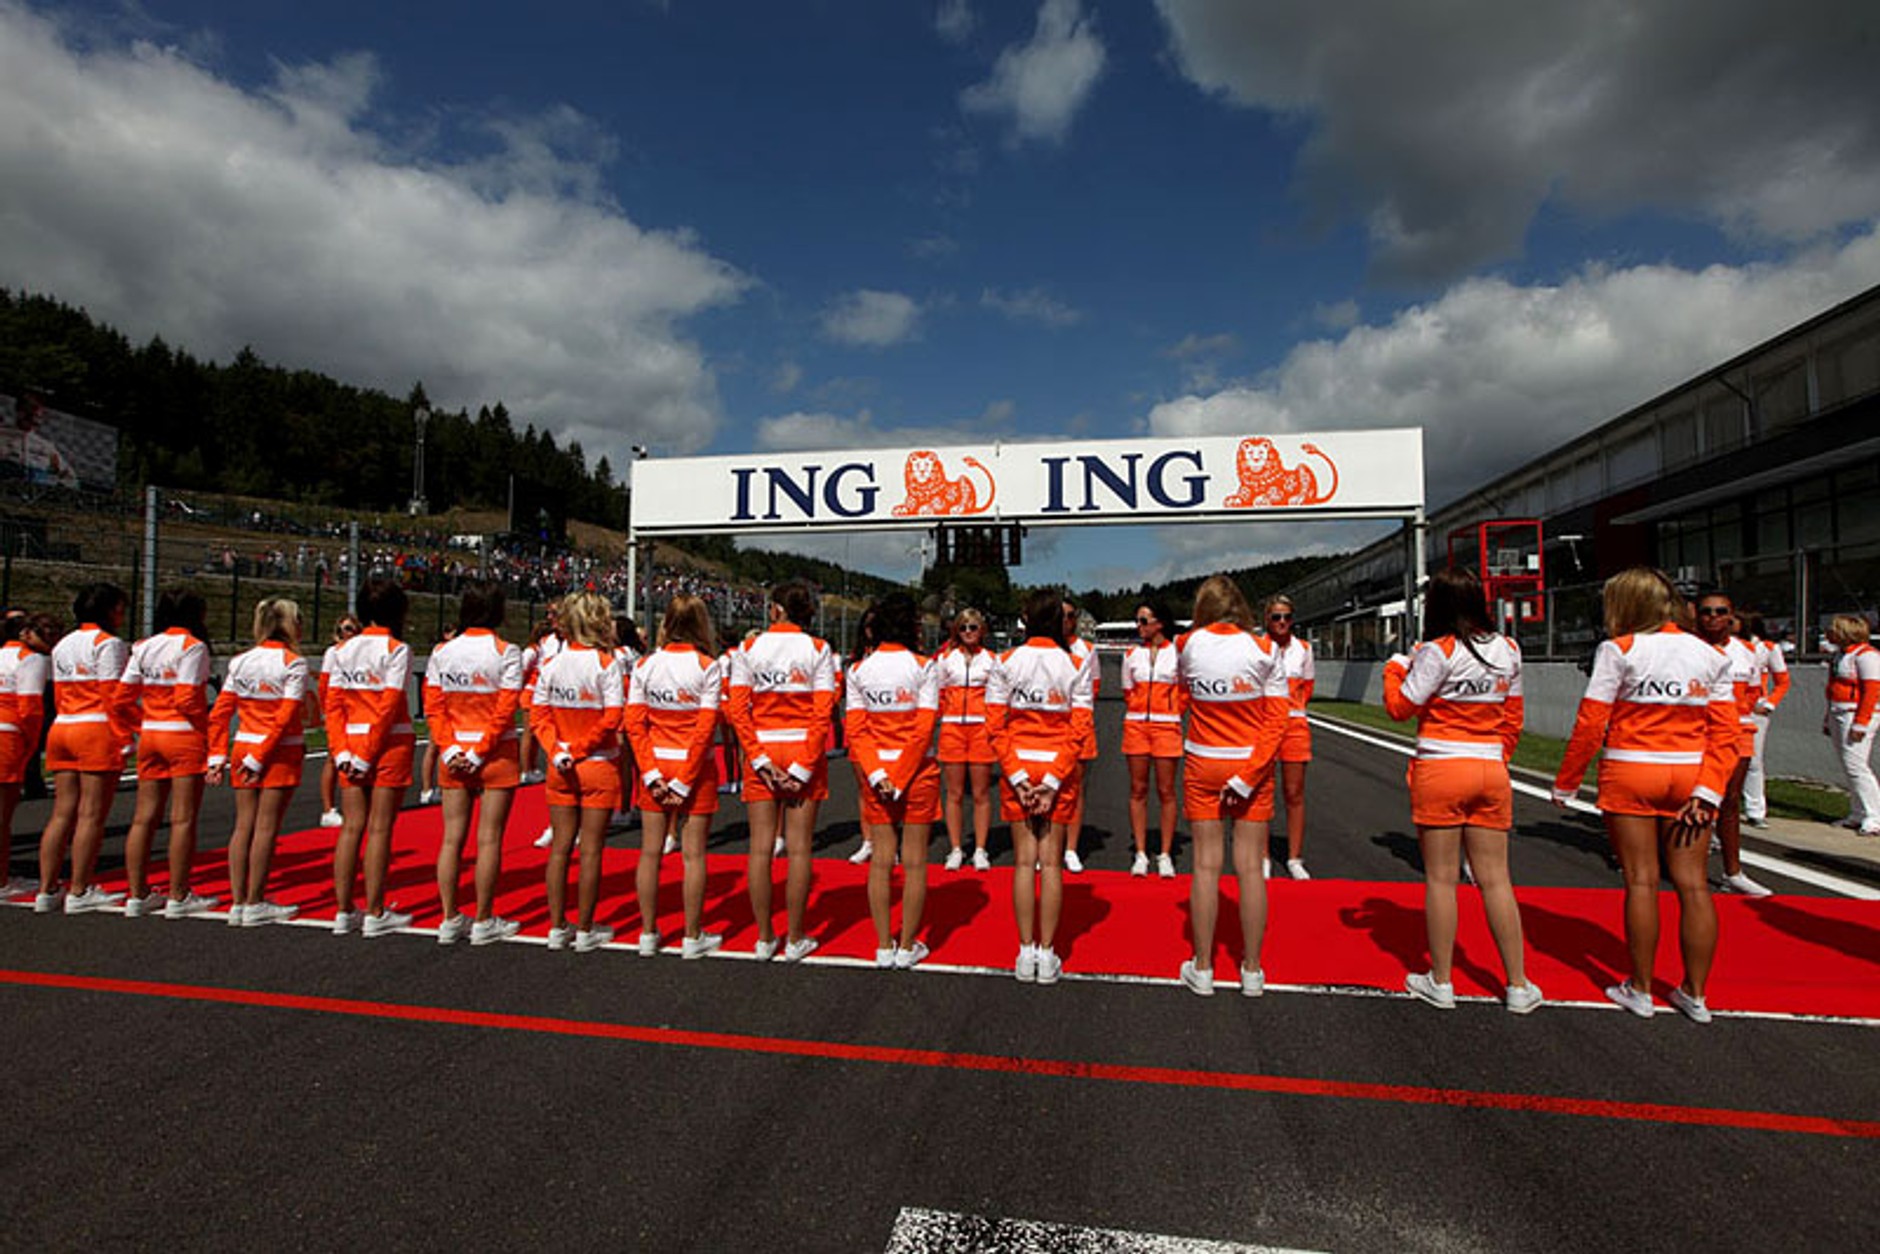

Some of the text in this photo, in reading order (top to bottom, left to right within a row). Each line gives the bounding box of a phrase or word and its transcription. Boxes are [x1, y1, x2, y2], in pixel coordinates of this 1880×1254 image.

[730, 462, 881, 520] ING
[1041, 450, 1212, 513] ING
[753, 671, 787, 685] ING
[1637, 680, 1682, 698] ING
